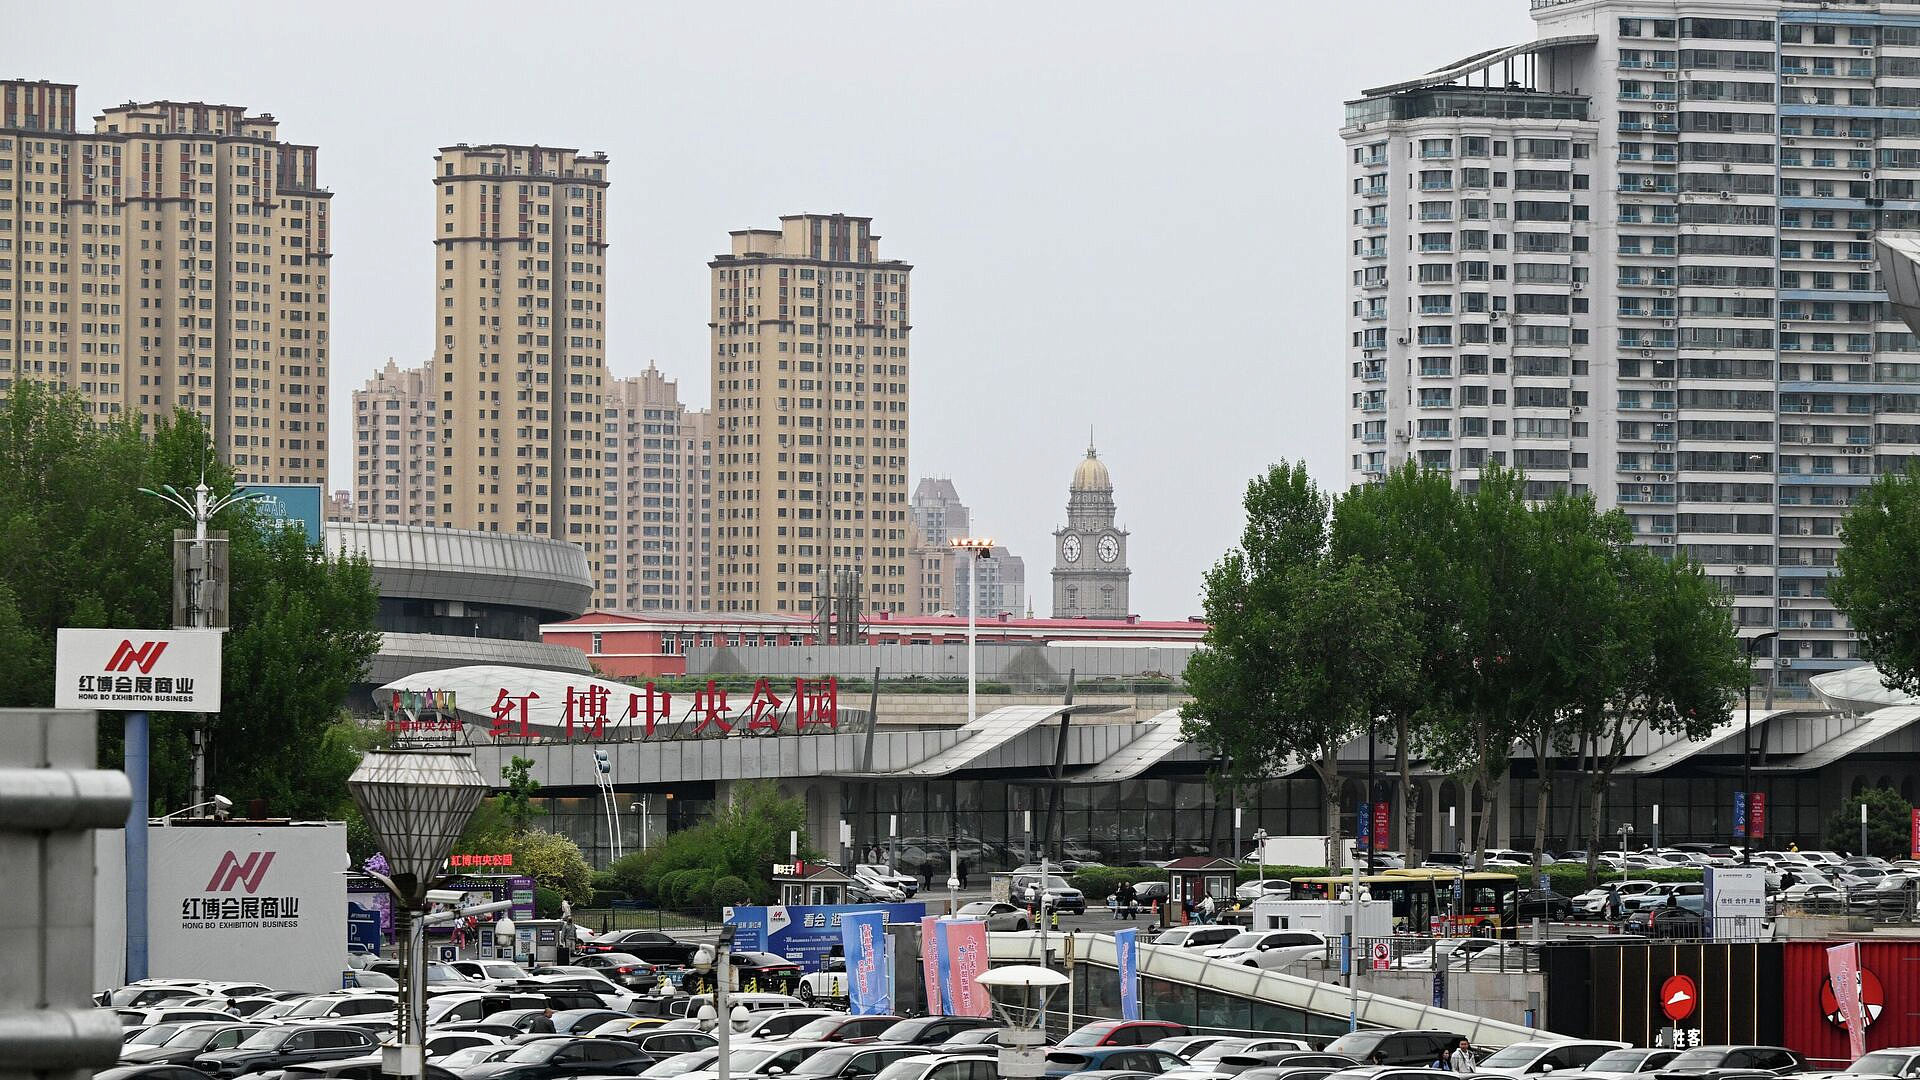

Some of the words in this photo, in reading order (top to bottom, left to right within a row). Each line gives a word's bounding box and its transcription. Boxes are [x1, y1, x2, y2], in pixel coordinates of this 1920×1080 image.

[78, 675, 194, 694] 红博会展商业
[111, 694, 153, 702] EXHIBITION
[154, 695, 193, 703] BUSINESS
[489, 676, 837, 738] 红博中央公园
[182, 896, 299, 920] 红博会展商业
[182, 922, 204, 930] HONG
[219, 921, 259, 929] EXHIBITION
[262, 920, 298, 928] BUSINESS
[803, 913, 825, 927] 看会
[350, 924, 358, 941] P
